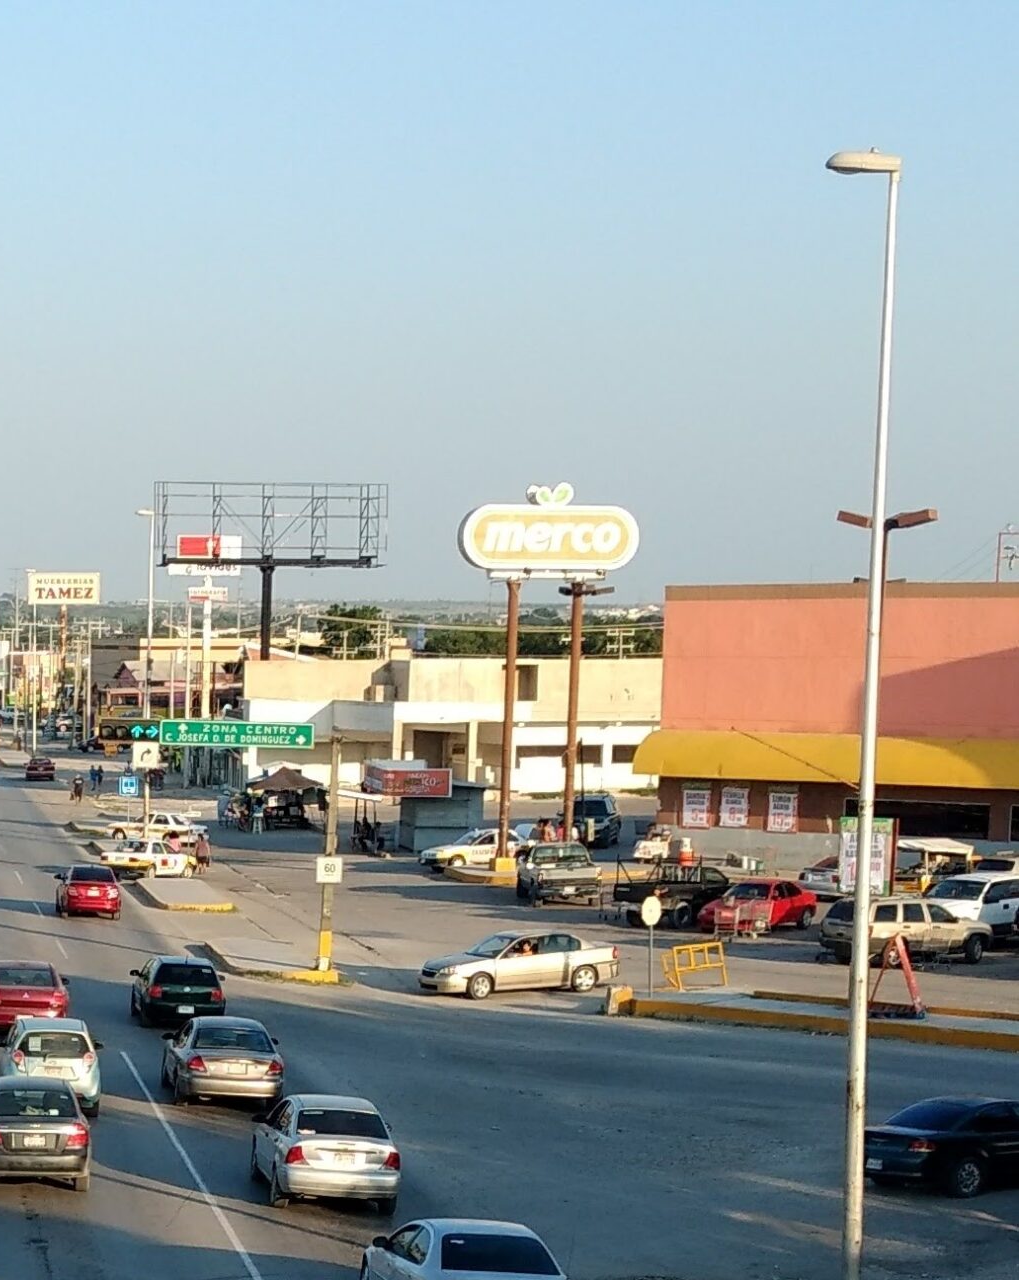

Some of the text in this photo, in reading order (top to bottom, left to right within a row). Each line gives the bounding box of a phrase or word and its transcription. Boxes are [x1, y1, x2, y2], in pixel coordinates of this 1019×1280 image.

[482, 521, 621, 553] merco
[34, 587, 94, 600] TAMEZ
[202, 724, 297, 735] ZONA CENTRO
[177, 733, 210, 743] JOSEFA
[224, 735, 236, 743] DE
[240, 735, 291, 745] DOMINGUEZ
[324, 863, 336, 873] 60
